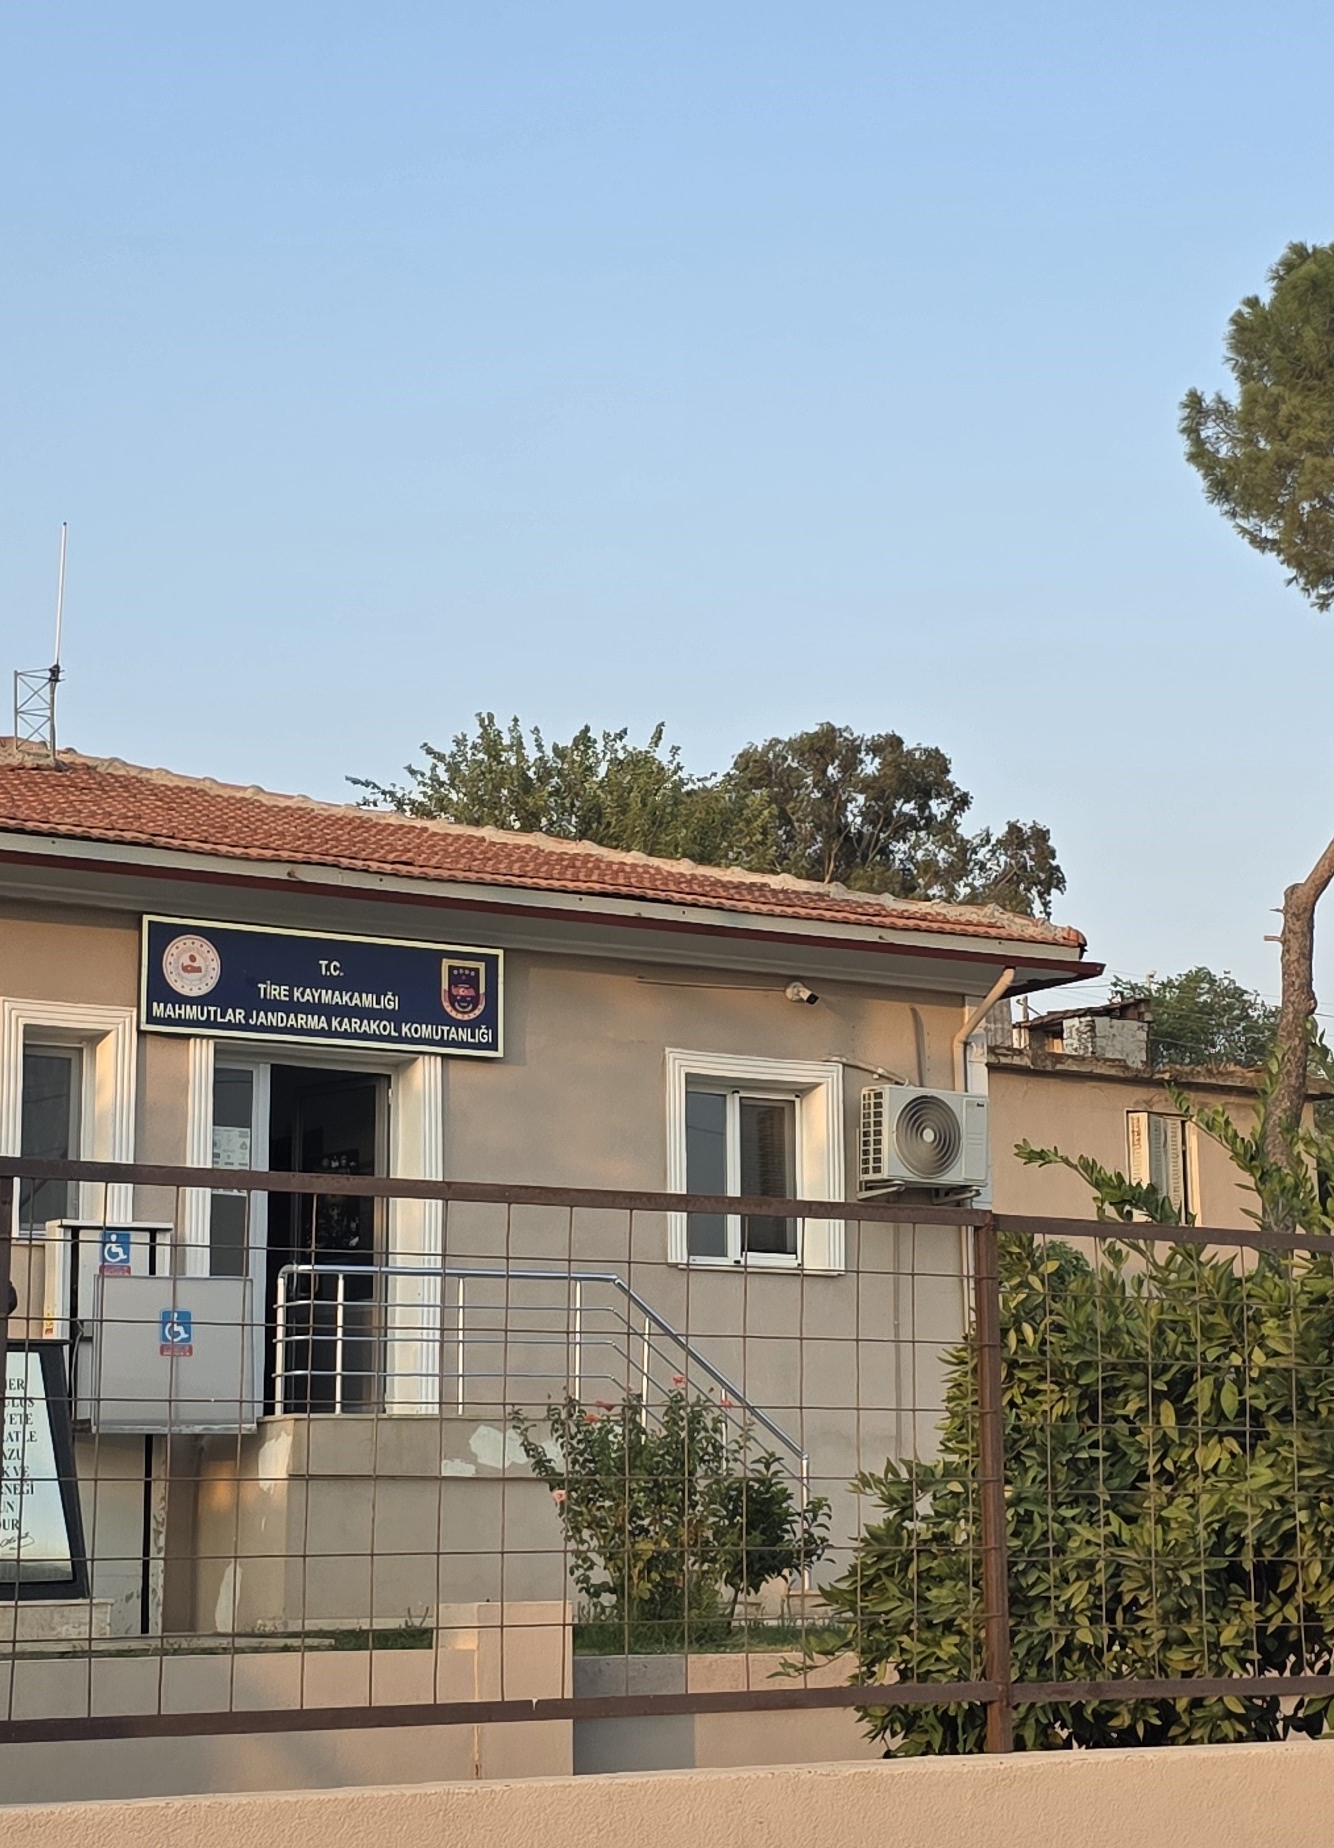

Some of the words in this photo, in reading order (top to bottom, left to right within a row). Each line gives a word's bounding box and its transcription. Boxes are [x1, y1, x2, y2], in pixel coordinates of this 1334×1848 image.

[319, 960, 344, 976] T.C.
[258, 980, 289, 1001] TİRE
[293, 986, 399, 1011] KAYMAKAMLIĞI
[152, 1002, 245, 1024] MAHMUTLAR
[249, 1011, 328, 1031] JANDARMA
[331, 1016, 398, 1037] KARAKOL
[401, 1023, 492, 1043] KOMUTANLIĞI
[2, 1378, 25, 1391] ER
